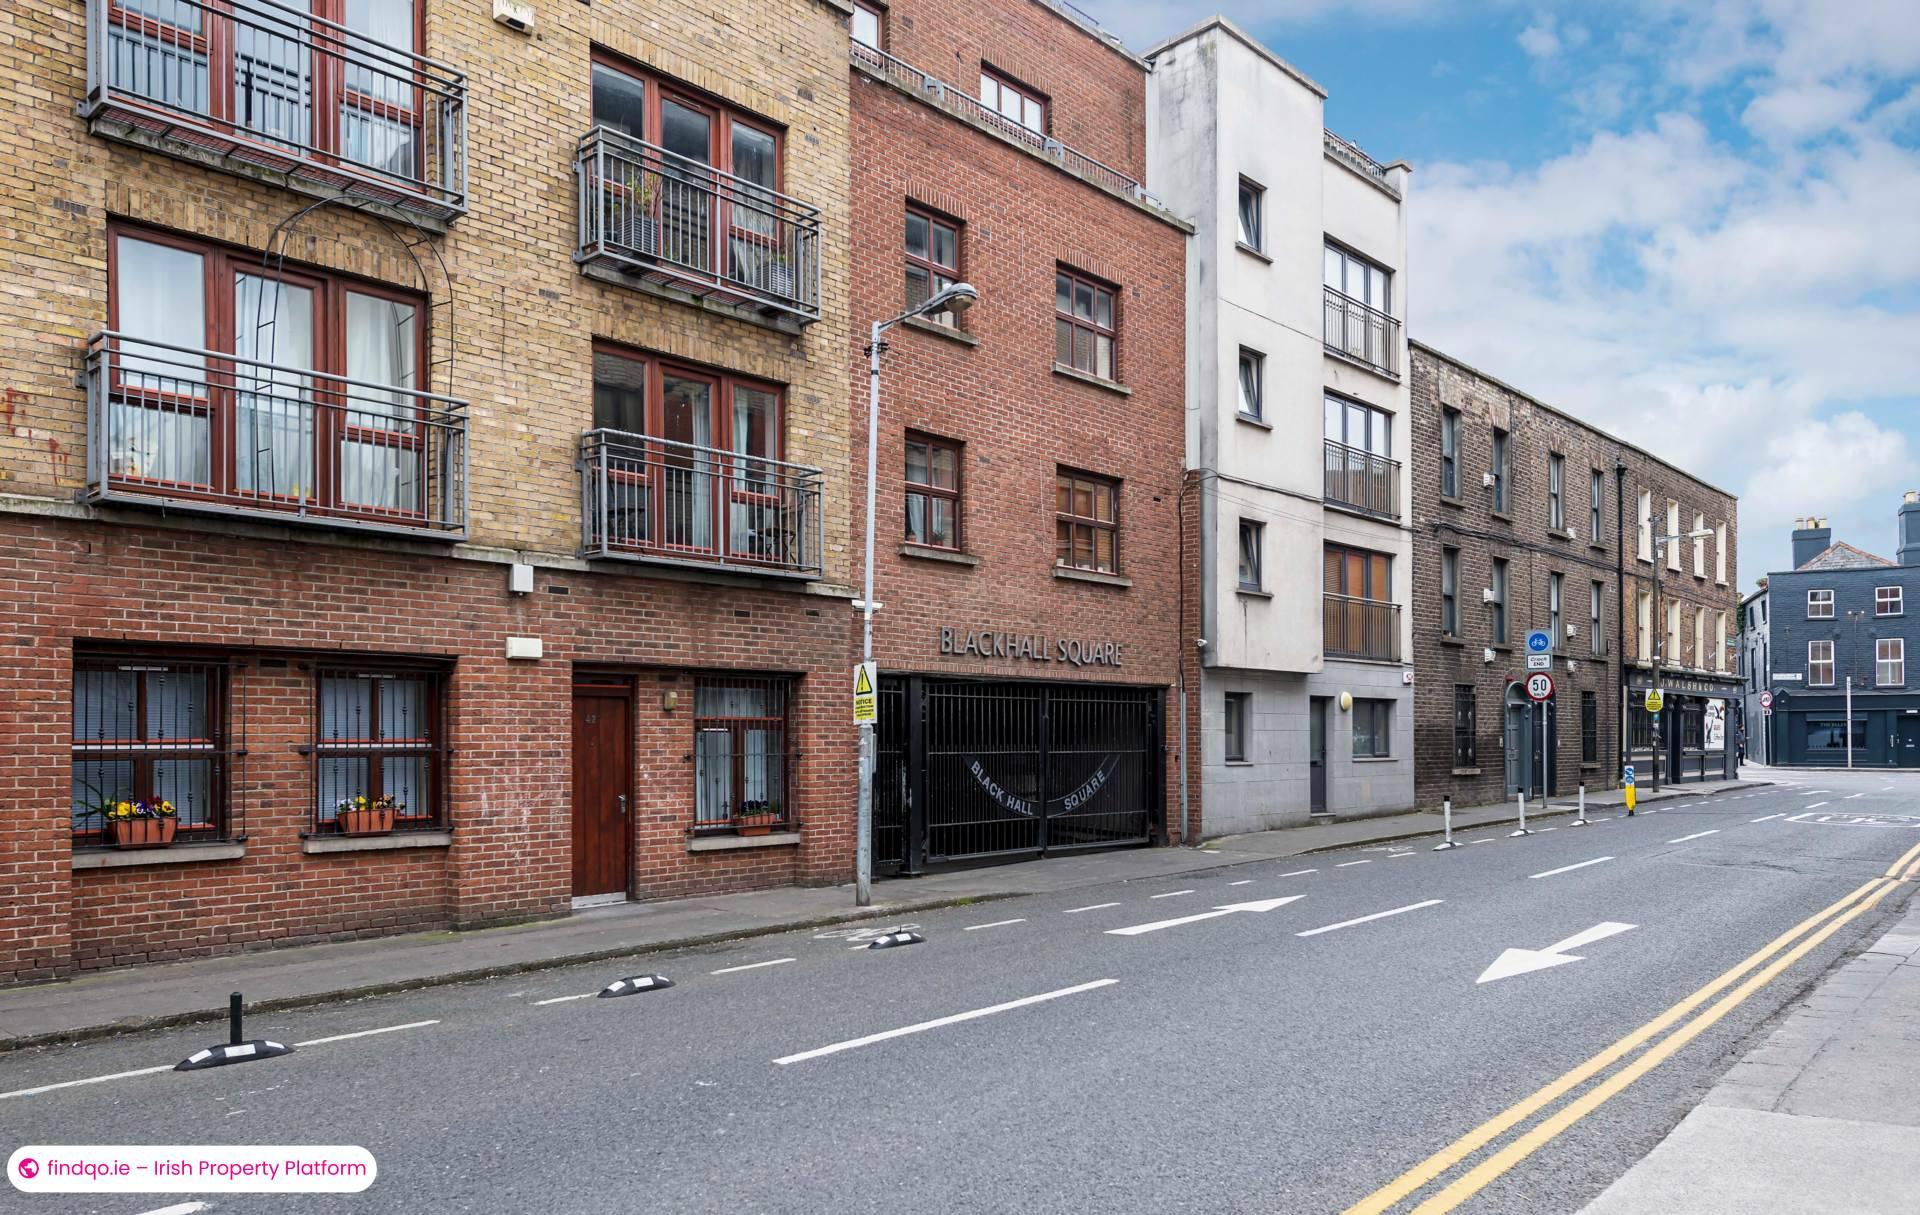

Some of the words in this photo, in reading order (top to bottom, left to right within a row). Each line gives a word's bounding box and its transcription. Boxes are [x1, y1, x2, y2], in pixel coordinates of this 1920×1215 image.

[940, 626, 1051, 660] BLACKHALL
[1057, 639, 1123, 667] SQUARE
[1532, 679, 1547, 691] 50
[971, 761, 1005, 802] BLACK
[1006, 795, 1033, 816] HALL
[1064, 770, 1106, 810] SQUARE
